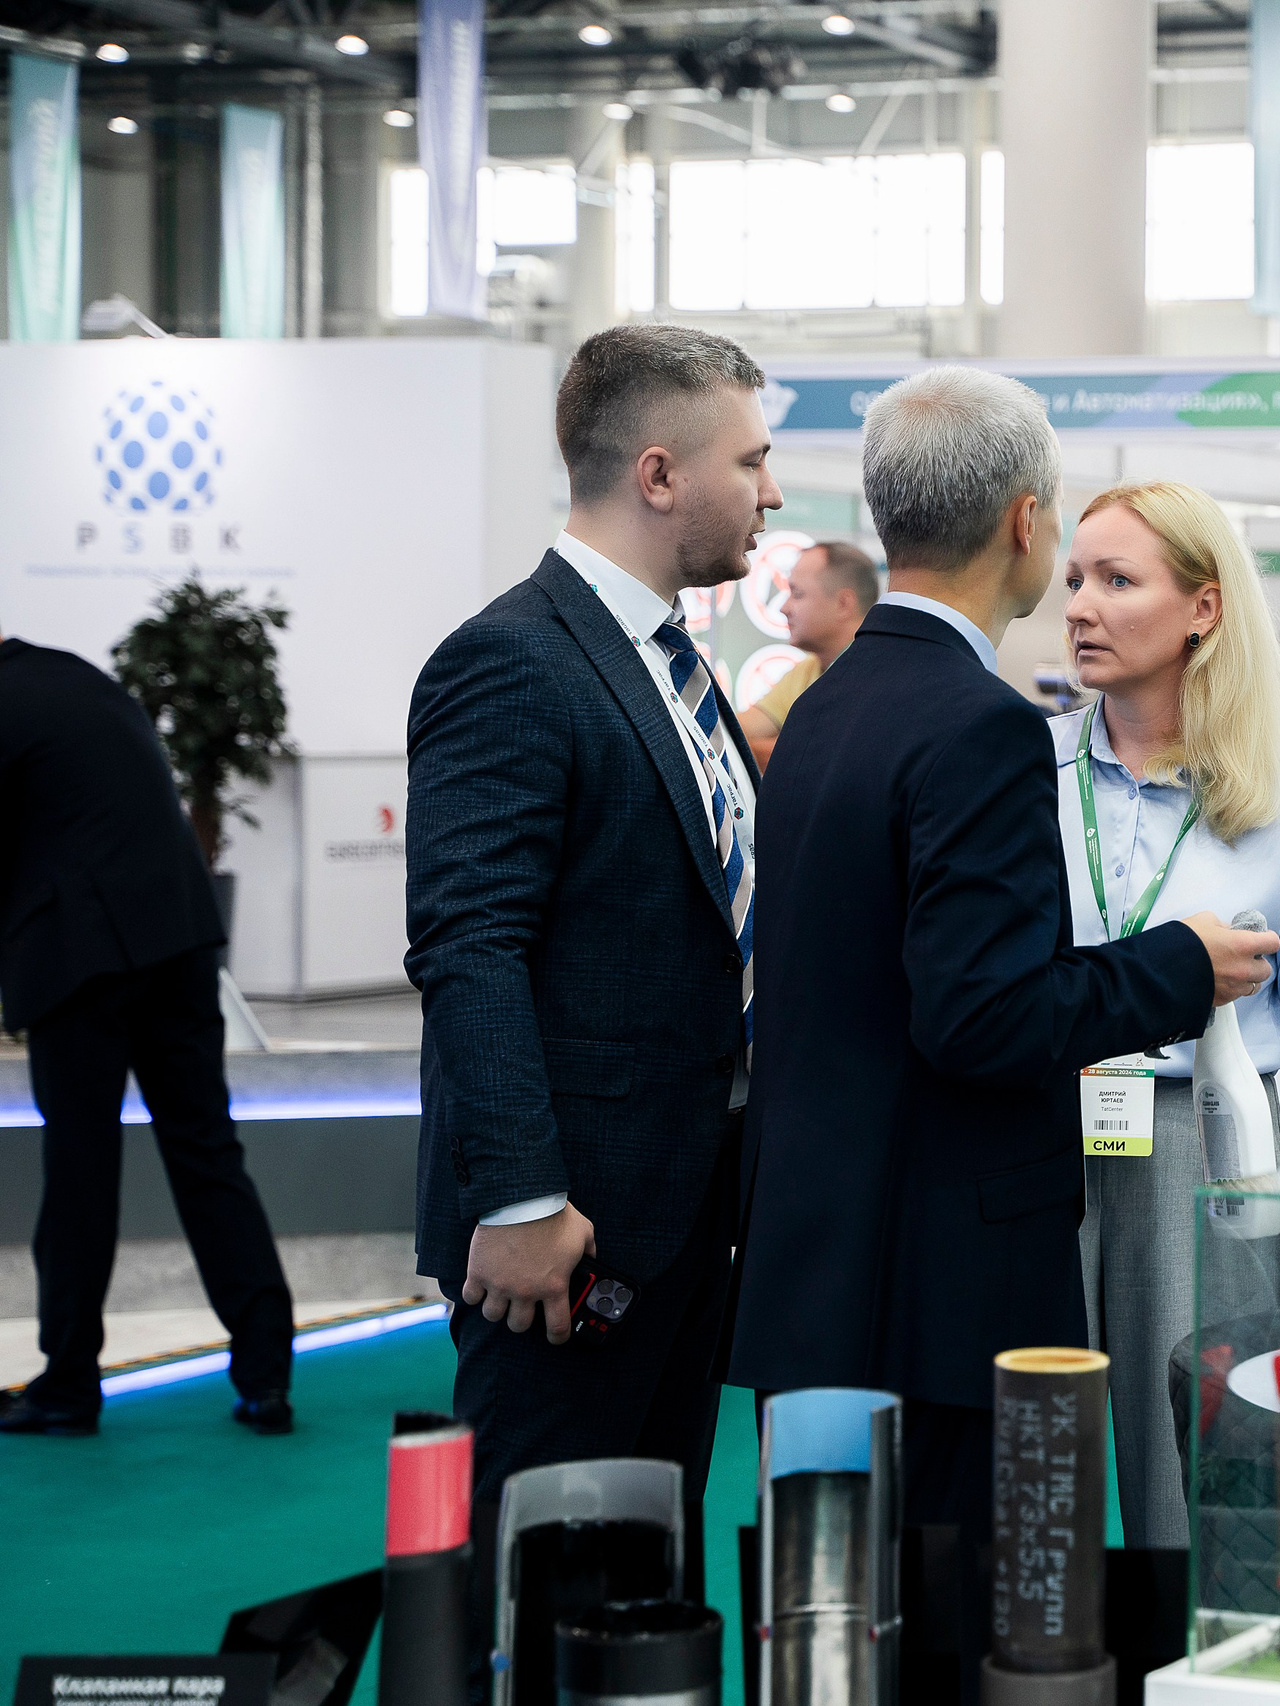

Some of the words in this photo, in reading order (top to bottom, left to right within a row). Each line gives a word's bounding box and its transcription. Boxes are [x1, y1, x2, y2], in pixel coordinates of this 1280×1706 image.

[1098, 1090, 1127, 1098] ДМИТРИЙ
[1093, 1140, 1126, 1151] СМИ
[1019, 1400, 1045, 1465] НКТ
[1050, 1452, 1077, 1516] ТМС
[1044, 1528, 1075, 1636] Групп
[52, 1675, 170, 1696] Клапанная
[171, 1676, 226, 1699] пара
